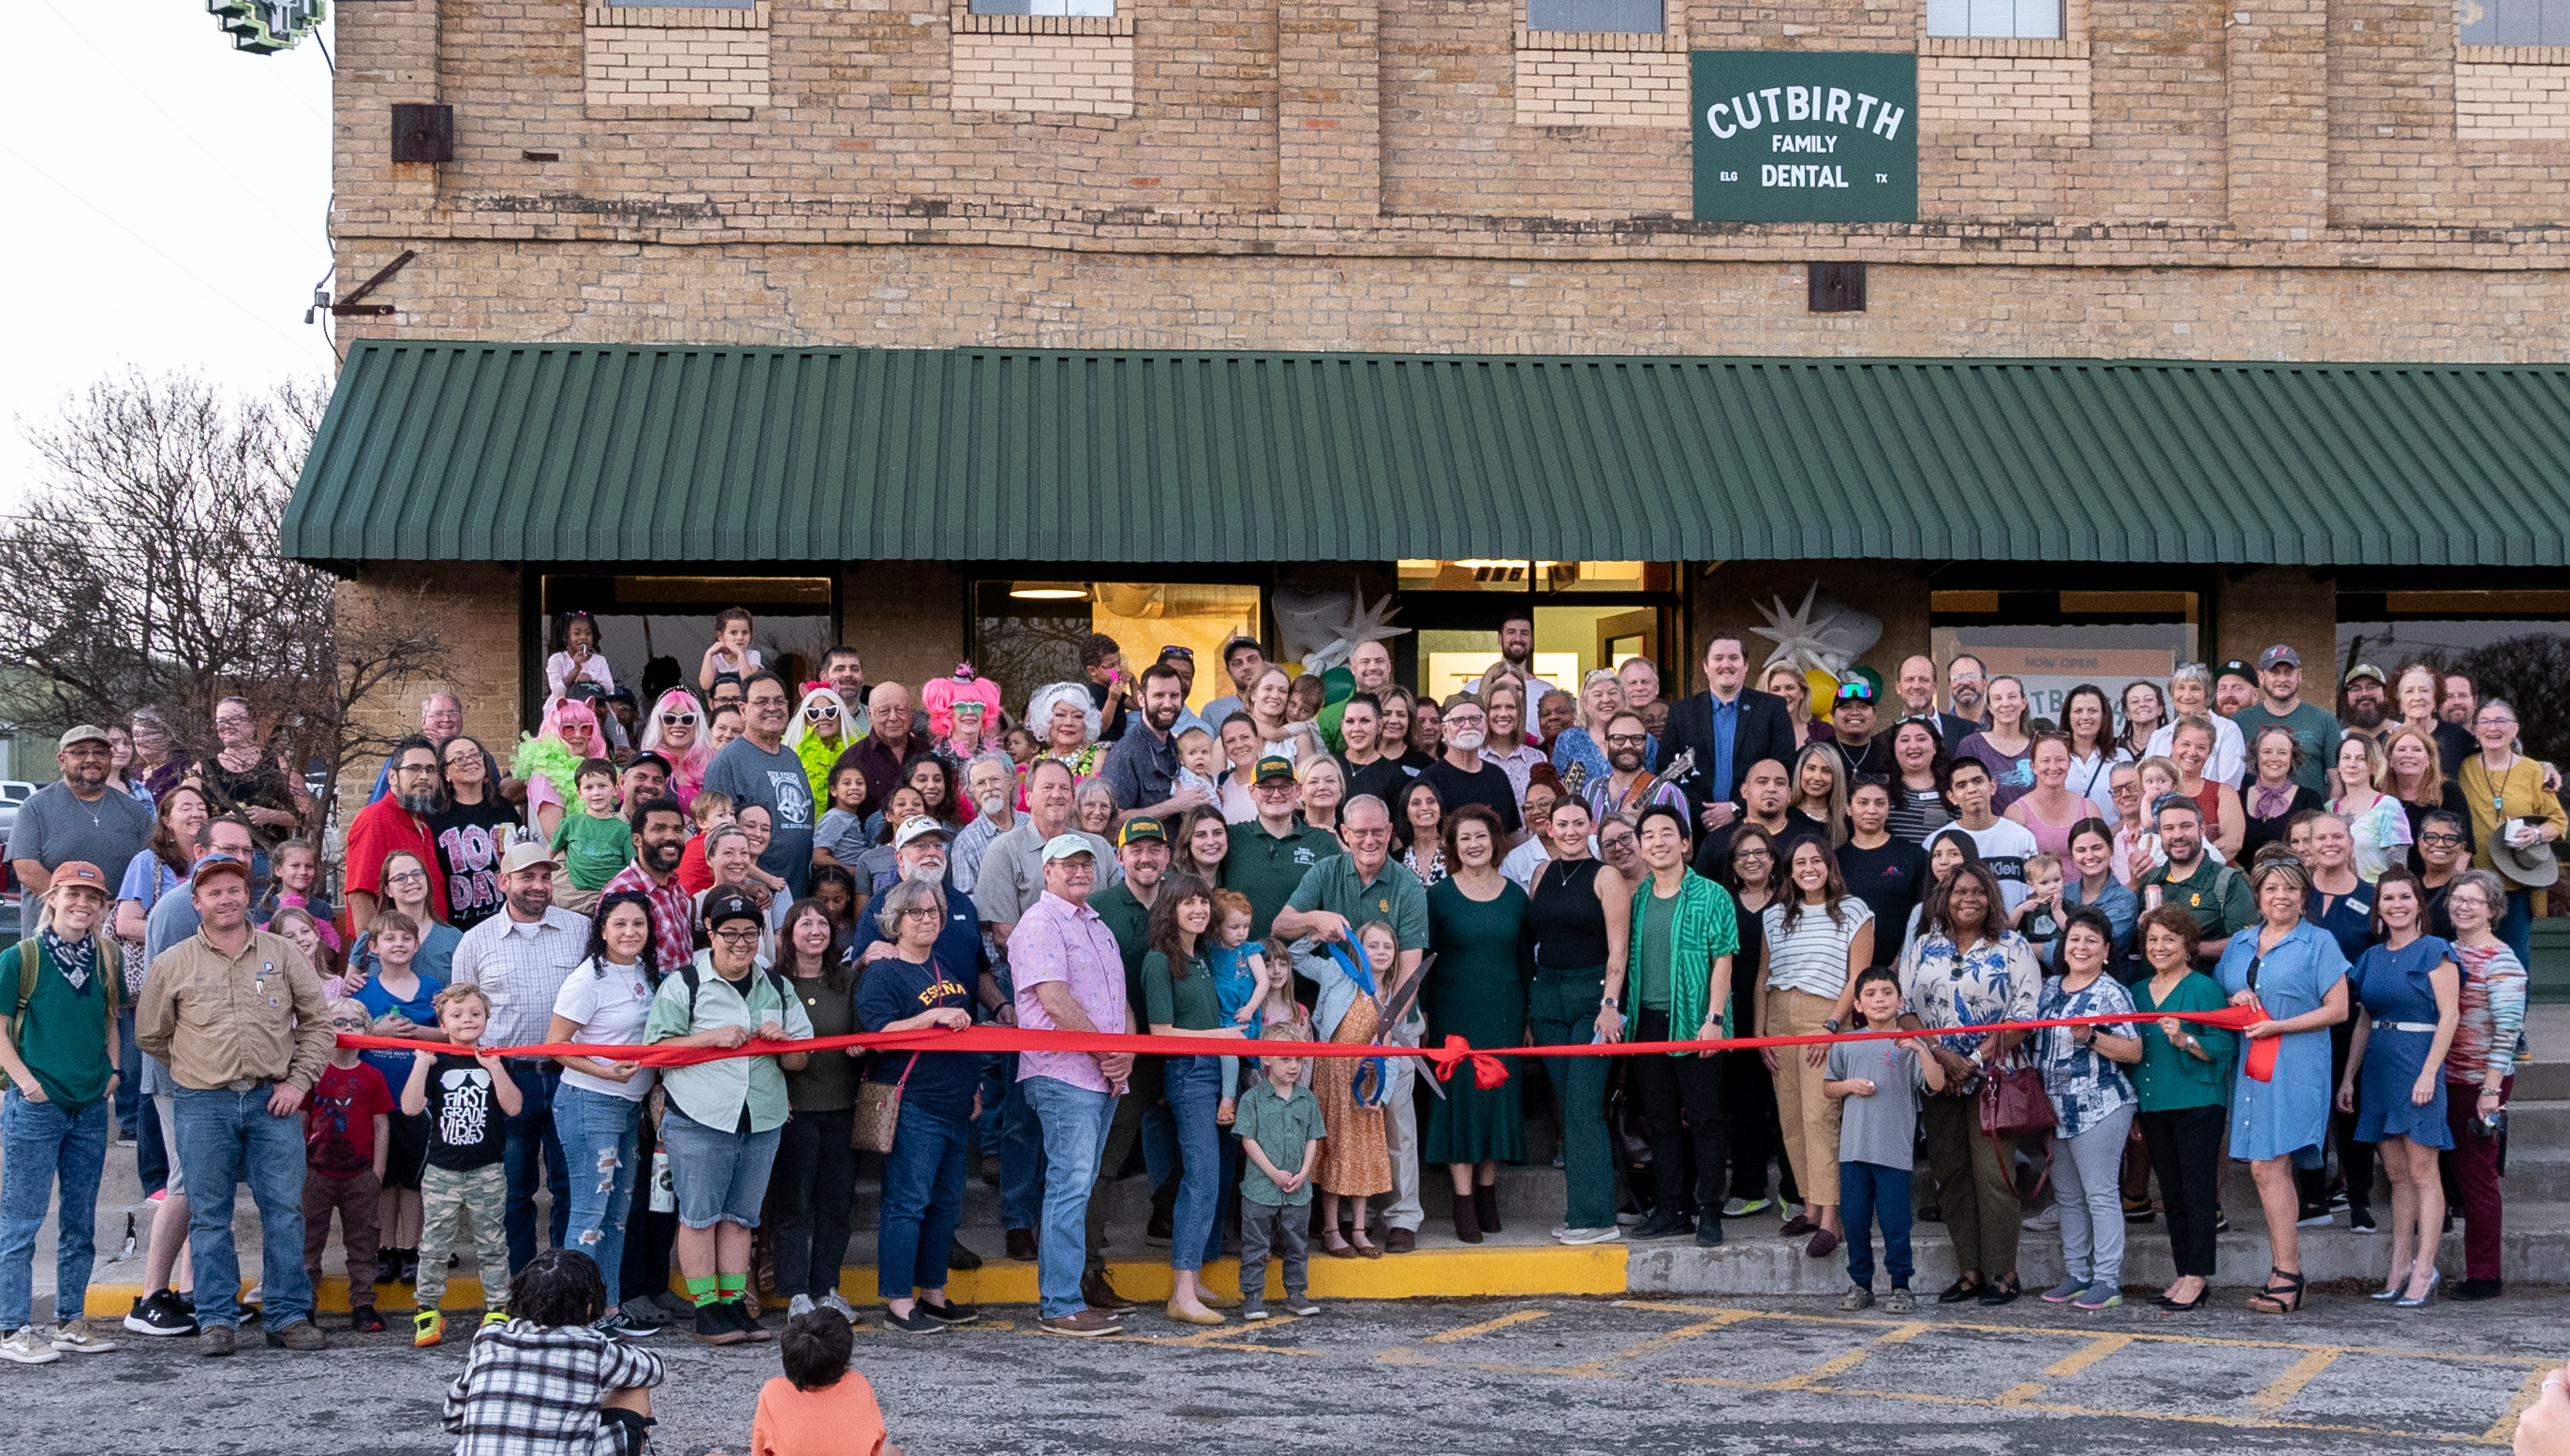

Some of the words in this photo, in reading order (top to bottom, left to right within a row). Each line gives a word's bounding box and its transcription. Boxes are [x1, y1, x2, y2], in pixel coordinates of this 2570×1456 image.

[1706, 85, 1905, 140] CUTBIRTH
[1772, 135, 1838, 153] FAMILY
[1720, 171, 1738, 182] ELG
[1761, 164, 1849, 188] DENTAL
[1875, 173, 1888, 184] TX
[1475, 566, 1524, 581] 116
[2024, 657, 2057, 668] NOW
[2060, 657, 2098, 669] OPEN!
[450, 869, 504, 911] DAY
[443, 1085, 488, 1108] FIRST
[442, 1107, 488, 1124] GRADE
[440, 1116, 485, 1144] VIBES
